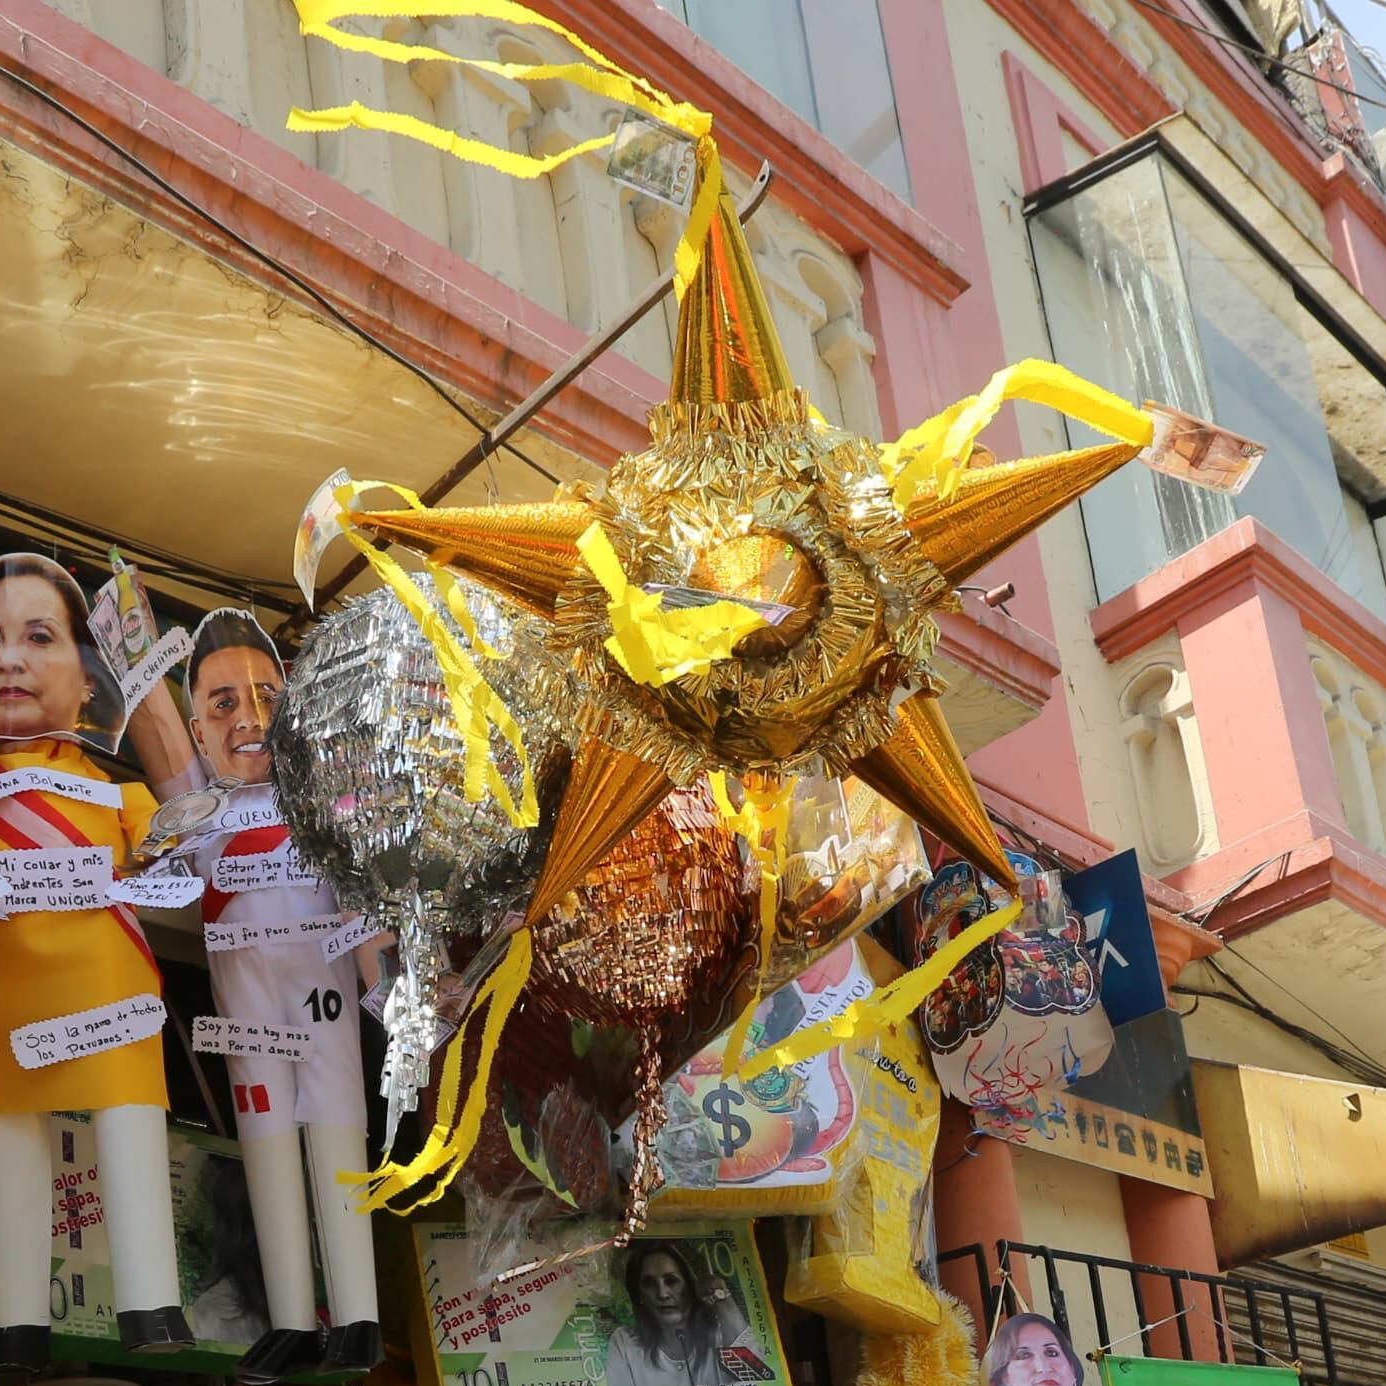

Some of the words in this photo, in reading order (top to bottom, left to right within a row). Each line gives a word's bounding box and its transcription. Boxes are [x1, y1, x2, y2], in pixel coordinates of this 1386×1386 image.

[68, 859, 76, 872] y
[206, 930, 234, 945] Soy
[302, 987, 343, 1023] 10
[65, 1026, 80, 1038] la
[197, 1020, 222, 1035] Soy
[53, 1170, 83, 1191] alor
[699, 1241, 735, 1277] 10
[435, 1296, 461, 1315] con
[442, 1311, 474, 1333] para
[478, 1294, 516, 1315] sopa,
[449, 1338, 459, 1350] y
[461, 1302, 532, 1344] postresito
